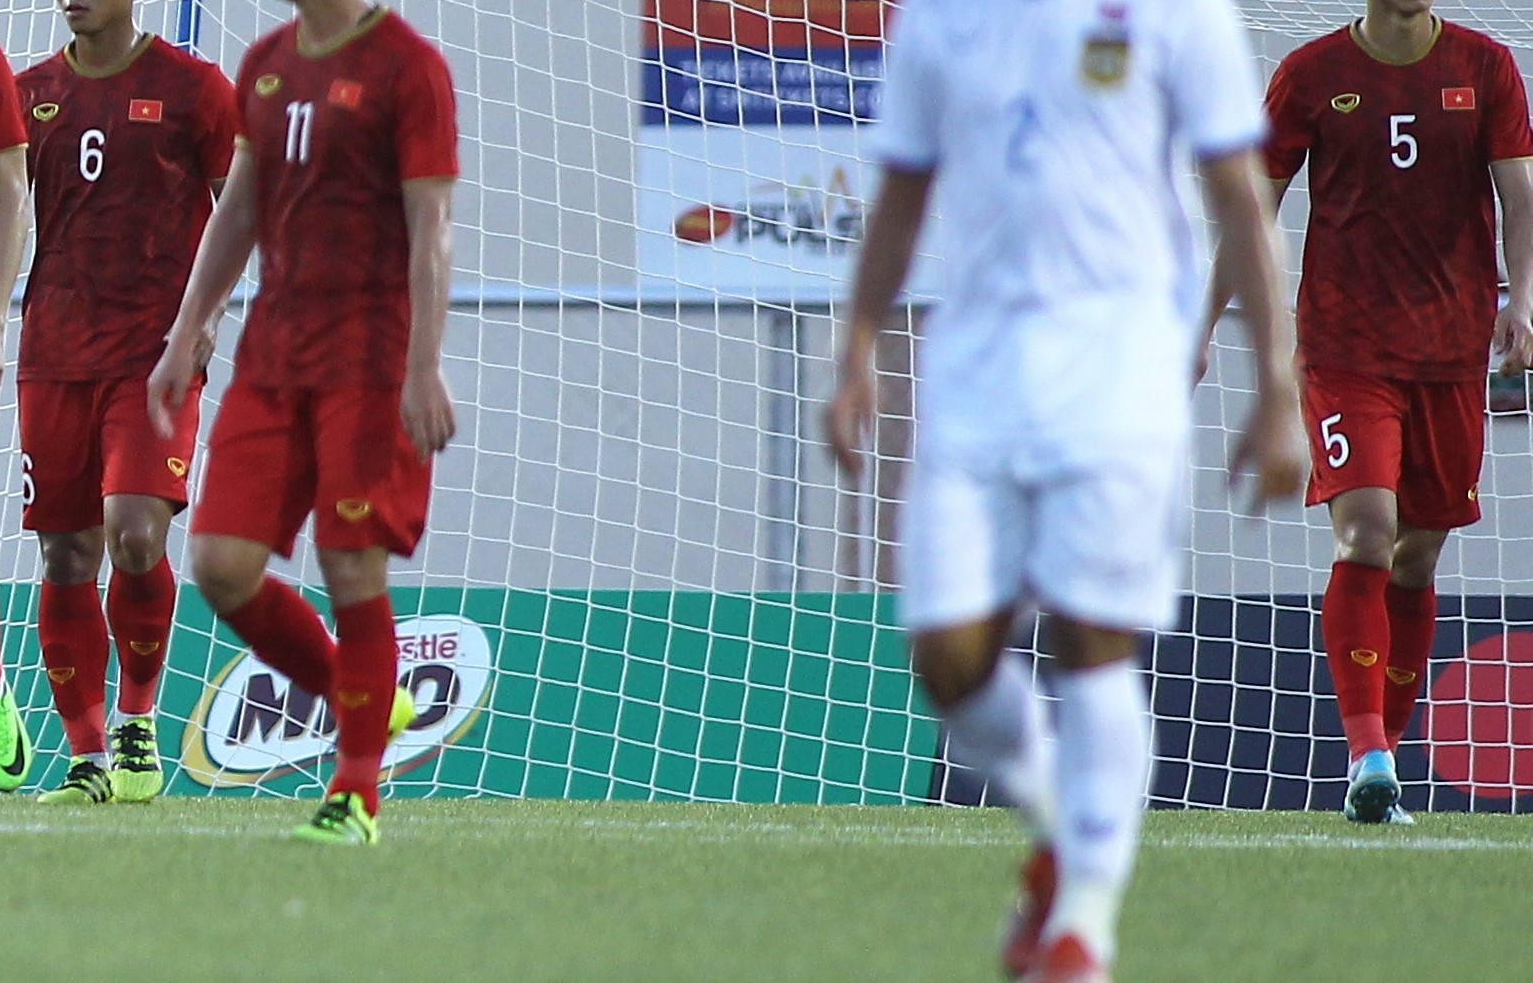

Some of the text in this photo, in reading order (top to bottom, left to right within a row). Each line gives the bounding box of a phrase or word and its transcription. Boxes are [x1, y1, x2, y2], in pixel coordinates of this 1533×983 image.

[79, 128, 106, 182] 6
[285, 100, 315, 164] 11
[1390, 114, 1418, 168] 5
[1321, 413, 1350, 468] 5
[223, 663, 461, 746] MIO
